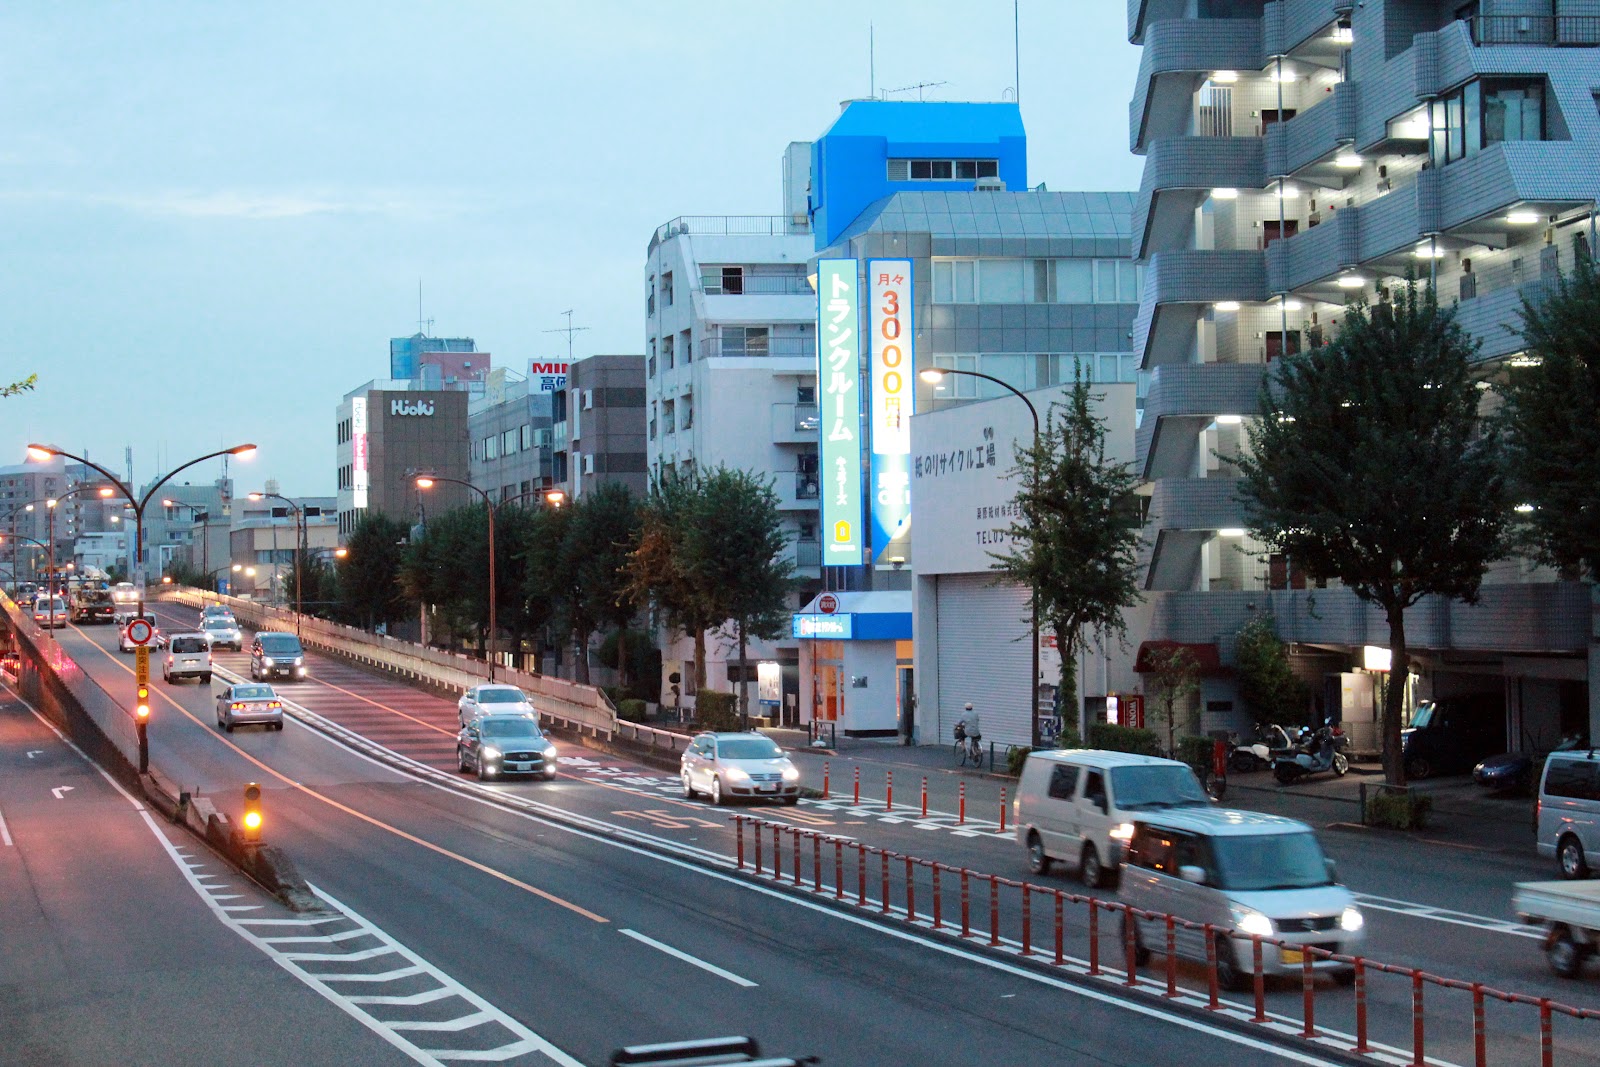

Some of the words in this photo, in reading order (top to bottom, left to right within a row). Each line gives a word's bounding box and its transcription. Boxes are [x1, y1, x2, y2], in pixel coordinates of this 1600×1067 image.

[877, 273, 904, 286] 月々
[826, 273, 854, 442] トランクルーム
[391, 399, 435, 416] Hioki
[915, 442, 996, 479] 紙のリサイクル工場
